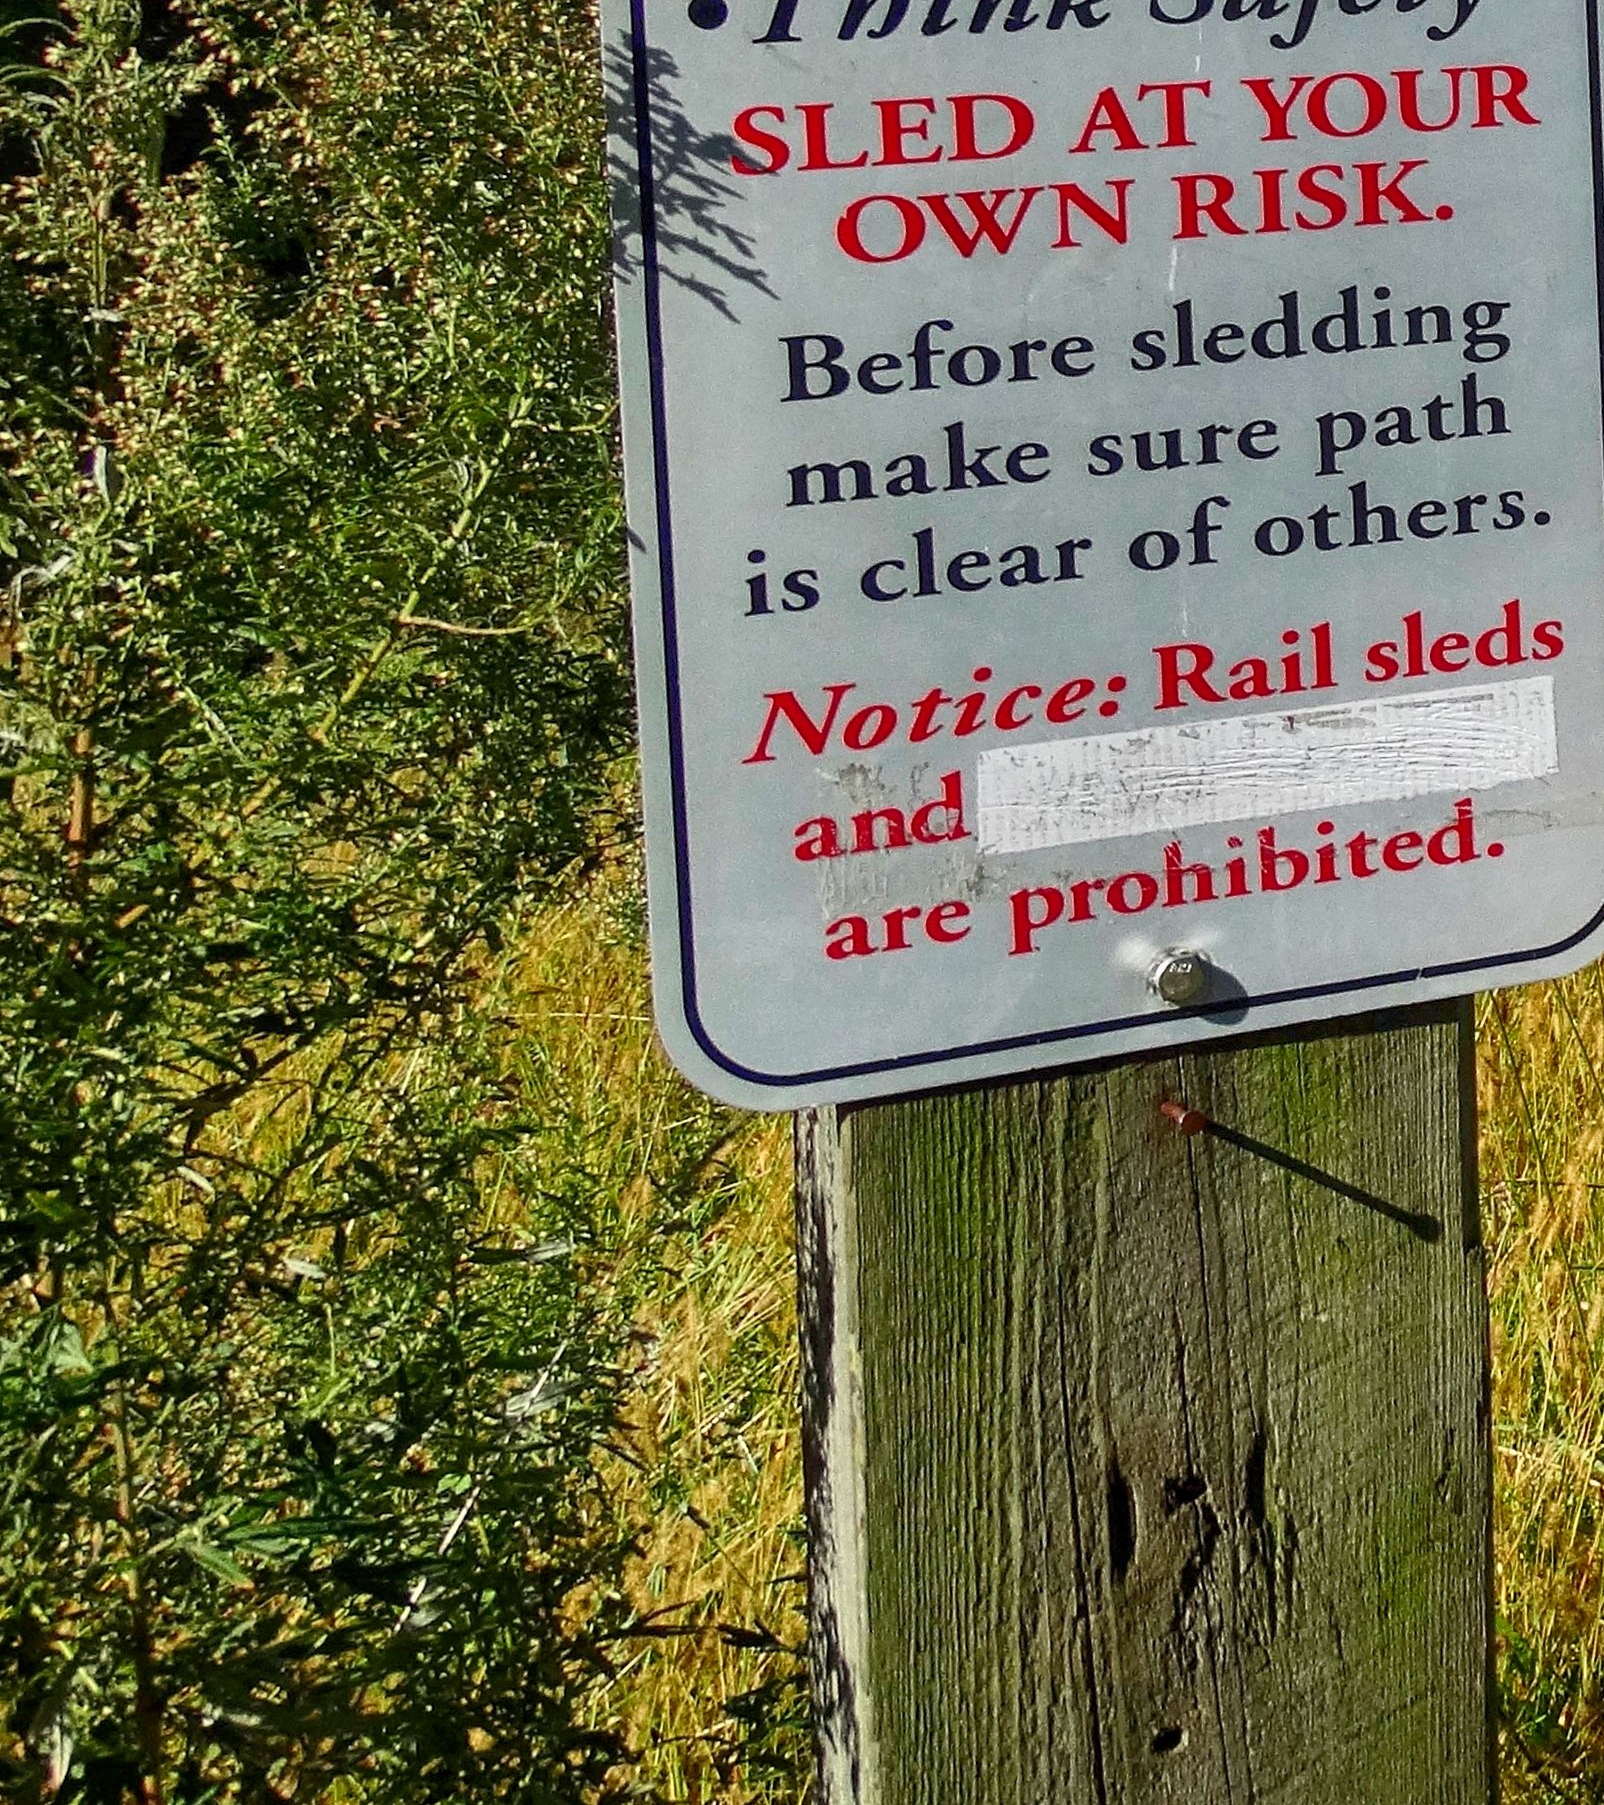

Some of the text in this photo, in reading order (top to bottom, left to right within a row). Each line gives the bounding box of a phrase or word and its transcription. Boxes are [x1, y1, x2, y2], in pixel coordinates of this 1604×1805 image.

[730, 63, 1540, 178] SLED AT YOUR
[834, 158, 1455, 265] OWN RISK.
[776, 283, 1513, 404] Before sledding
[784, 370, 1513, 509] make sure path
[742, 478, 1552, 618] is clear of others.
[745, 598, 1565, 766] Notice: Rail sleds
[792, 769, 970, 863] and
[823, 796, 1506, 962] are prohibited.
